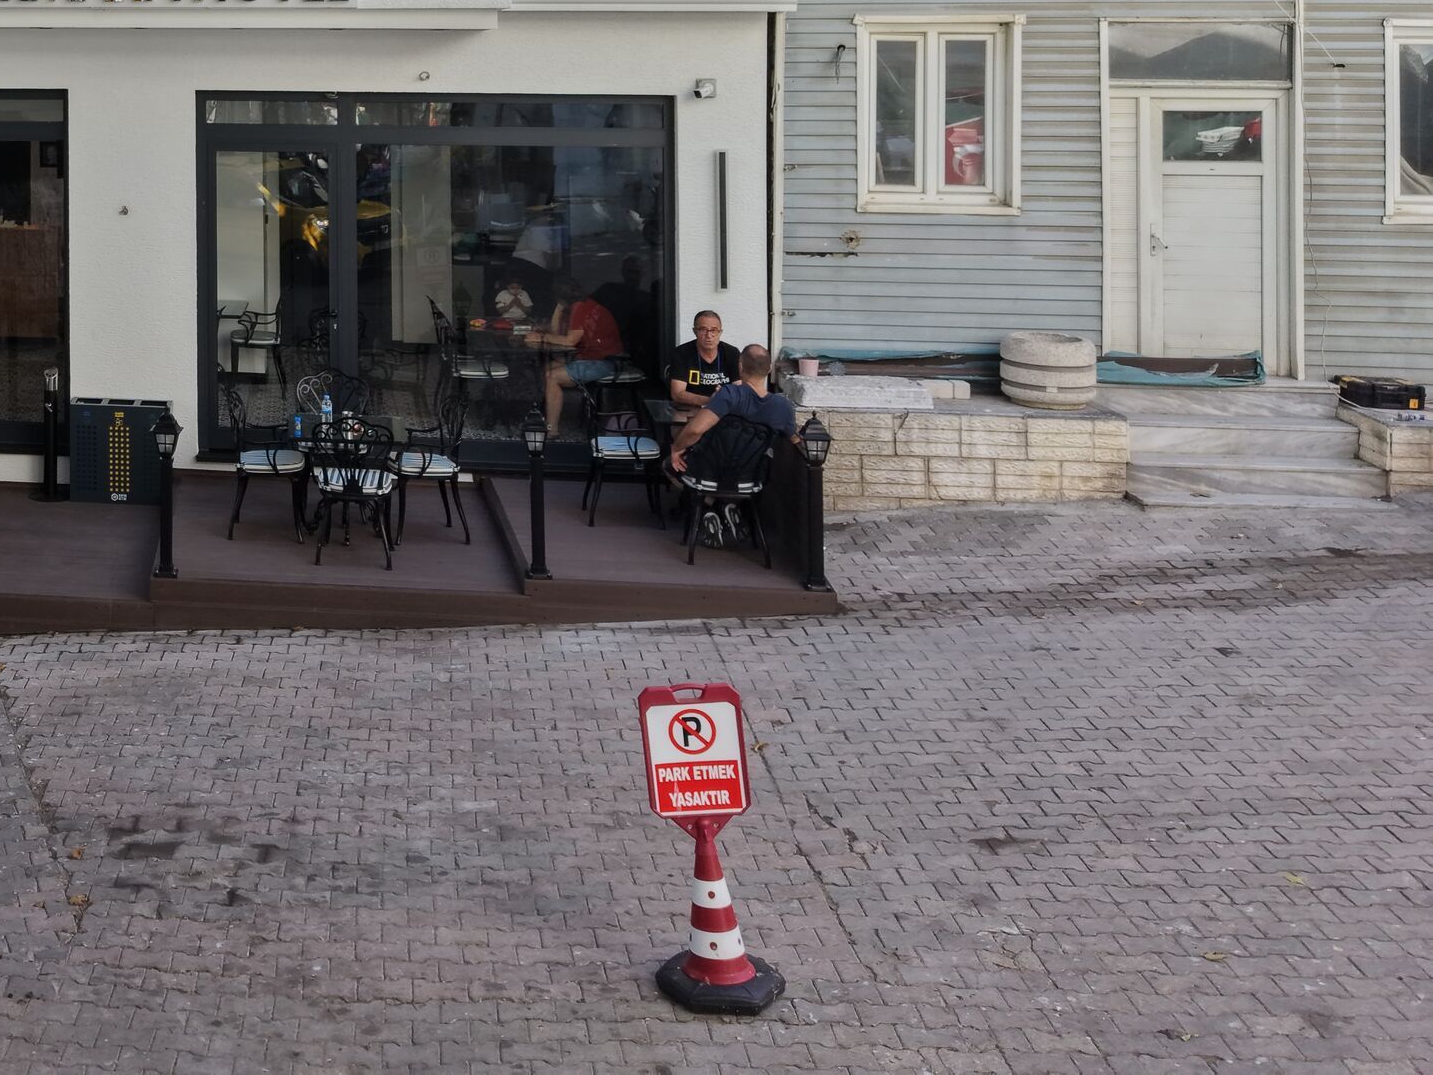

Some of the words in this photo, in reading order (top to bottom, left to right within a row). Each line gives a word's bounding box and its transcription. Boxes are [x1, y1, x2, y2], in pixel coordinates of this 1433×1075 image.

[658, 767, 691, 782] PARK
[693, 765, 736, 780] ETMEK
[669, 790, 730, 807] YASAKTIR
